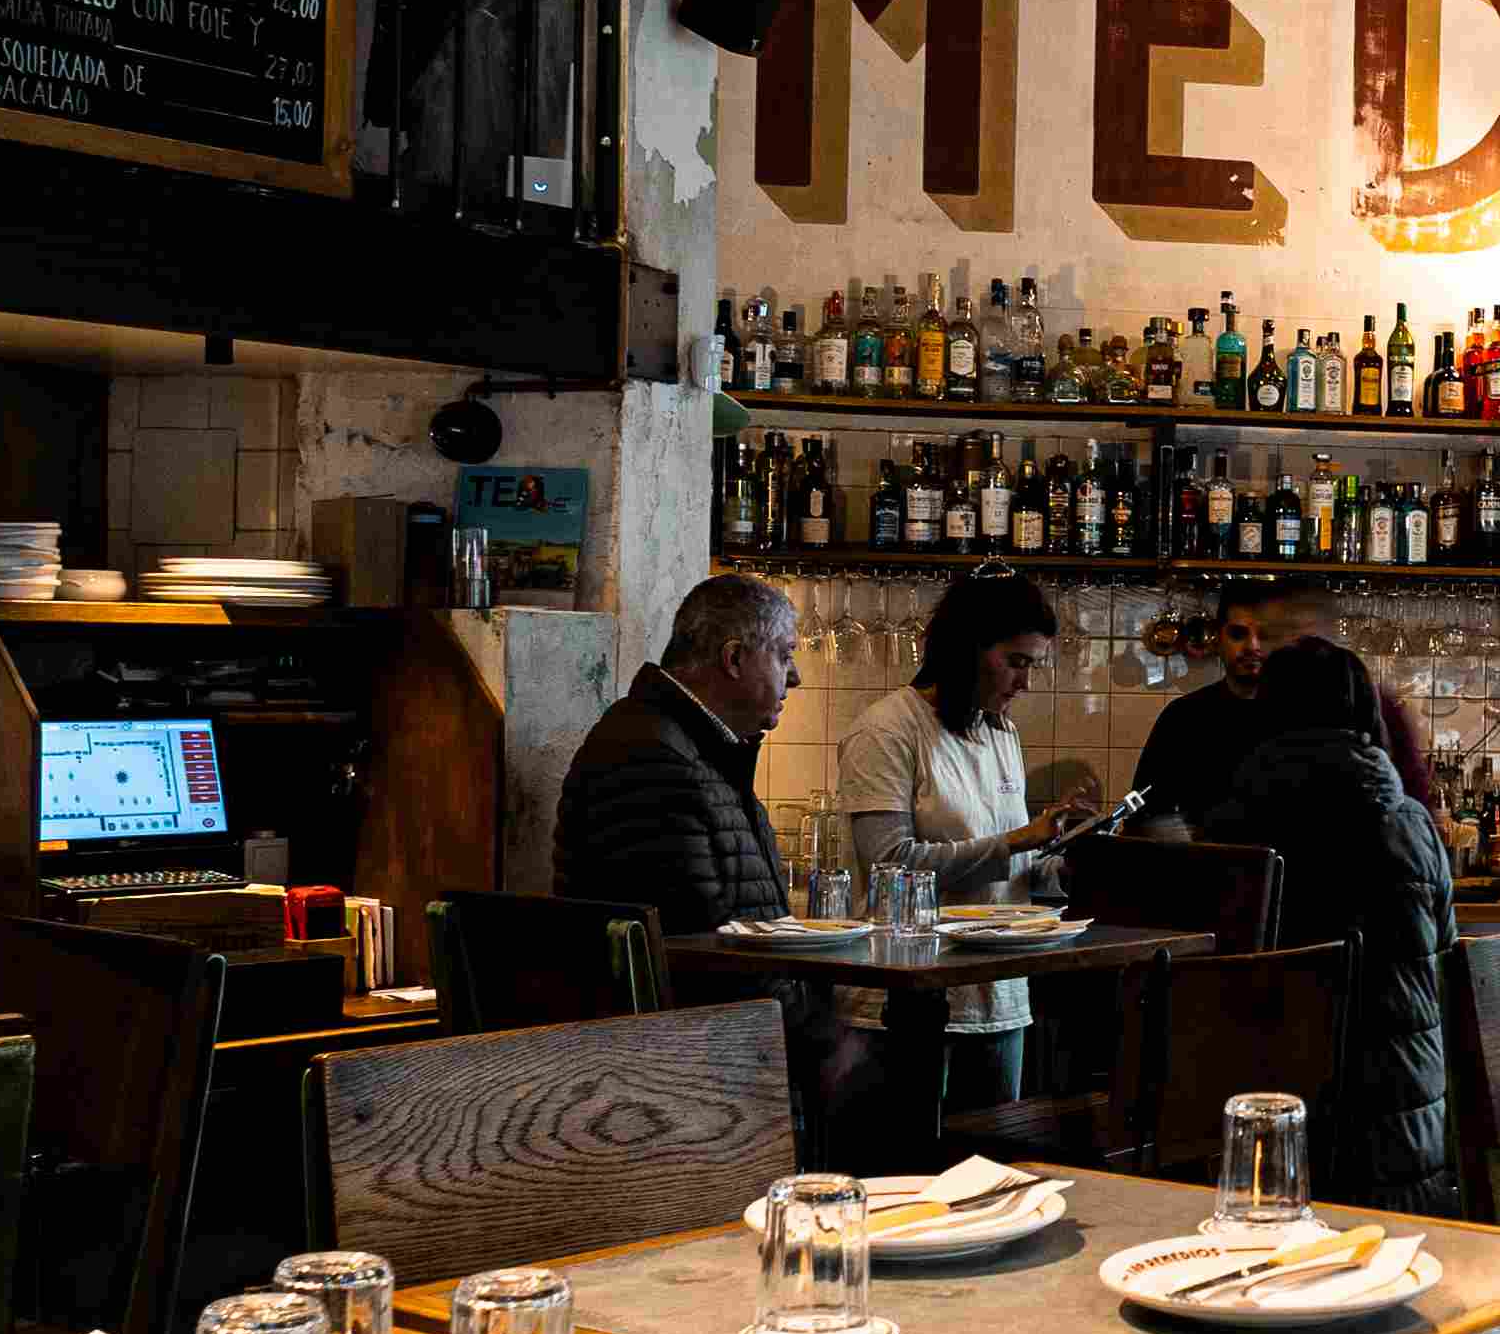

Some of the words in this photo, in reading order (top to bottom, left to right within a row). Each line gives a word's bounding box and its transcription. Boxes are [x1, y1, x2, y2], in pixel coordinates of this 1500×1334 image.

[188, 0, 233, 40] FOIE
[249, 17, 264, 46] Y
[124, 64, 146, 96] DE
